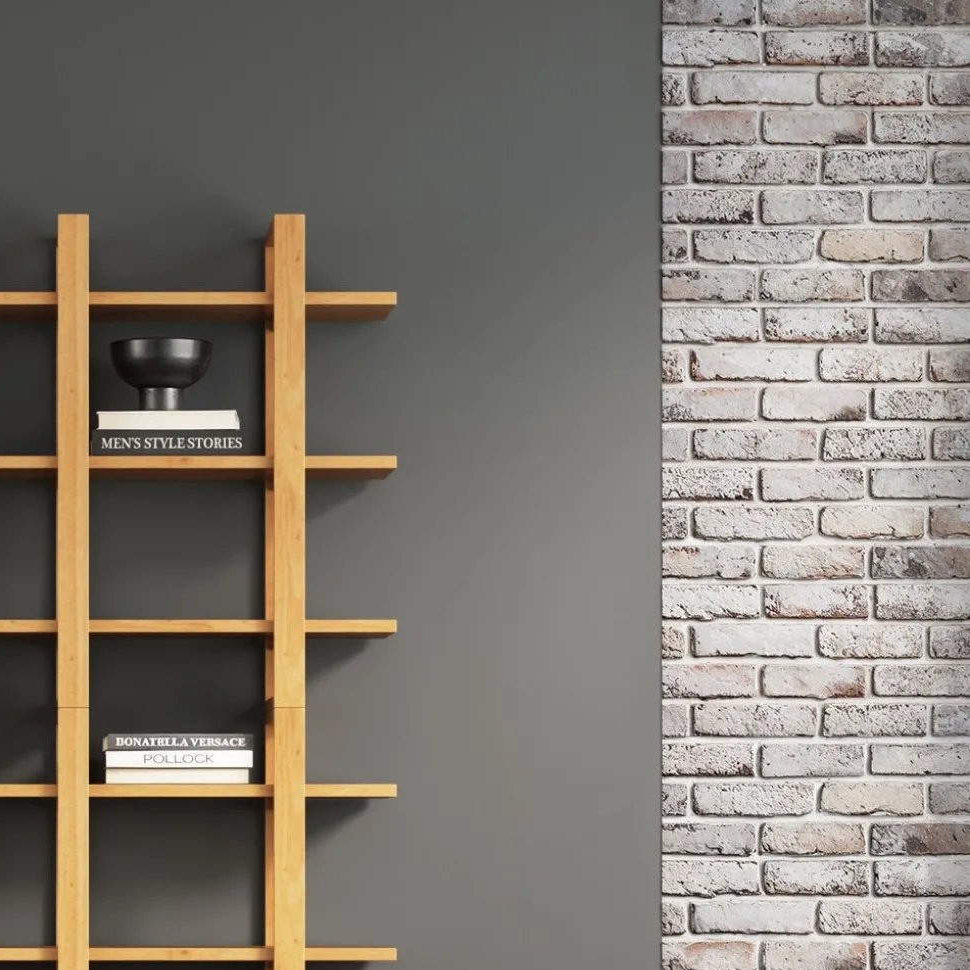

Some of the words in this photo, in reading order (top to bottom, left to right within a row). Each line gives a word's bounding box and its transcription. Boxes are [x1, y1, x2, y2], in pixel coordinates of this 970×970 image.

[101, 437, 141, 449] MEN'S
[143, 437, 186, 449] STYLE
[187, 436, 243, 449] STORIES
[189, 737, 246, 747] VERSACE
[143, 753, 214, 764] POLLOCK
